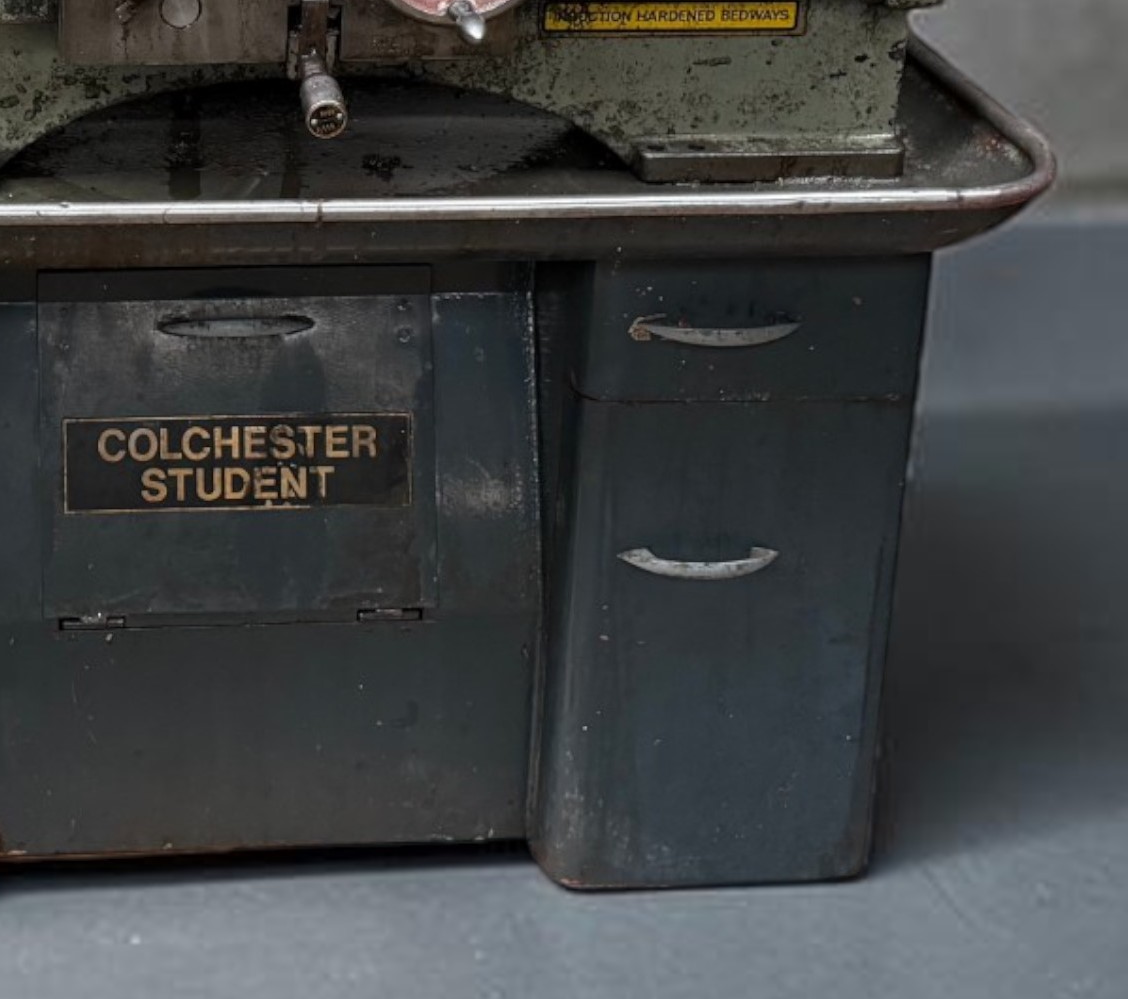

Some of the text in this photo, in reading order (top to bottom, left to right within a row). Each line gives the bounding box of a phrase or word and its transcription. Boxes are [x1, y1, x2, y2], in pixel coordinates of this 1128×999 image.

[637, 9, 715, 22] HARDENED
[721, 8, 789, 21] BEDWAYS
[97, 424, 377, 463] COLCHESTER
[140, 465, 335, 502] STUDENT
